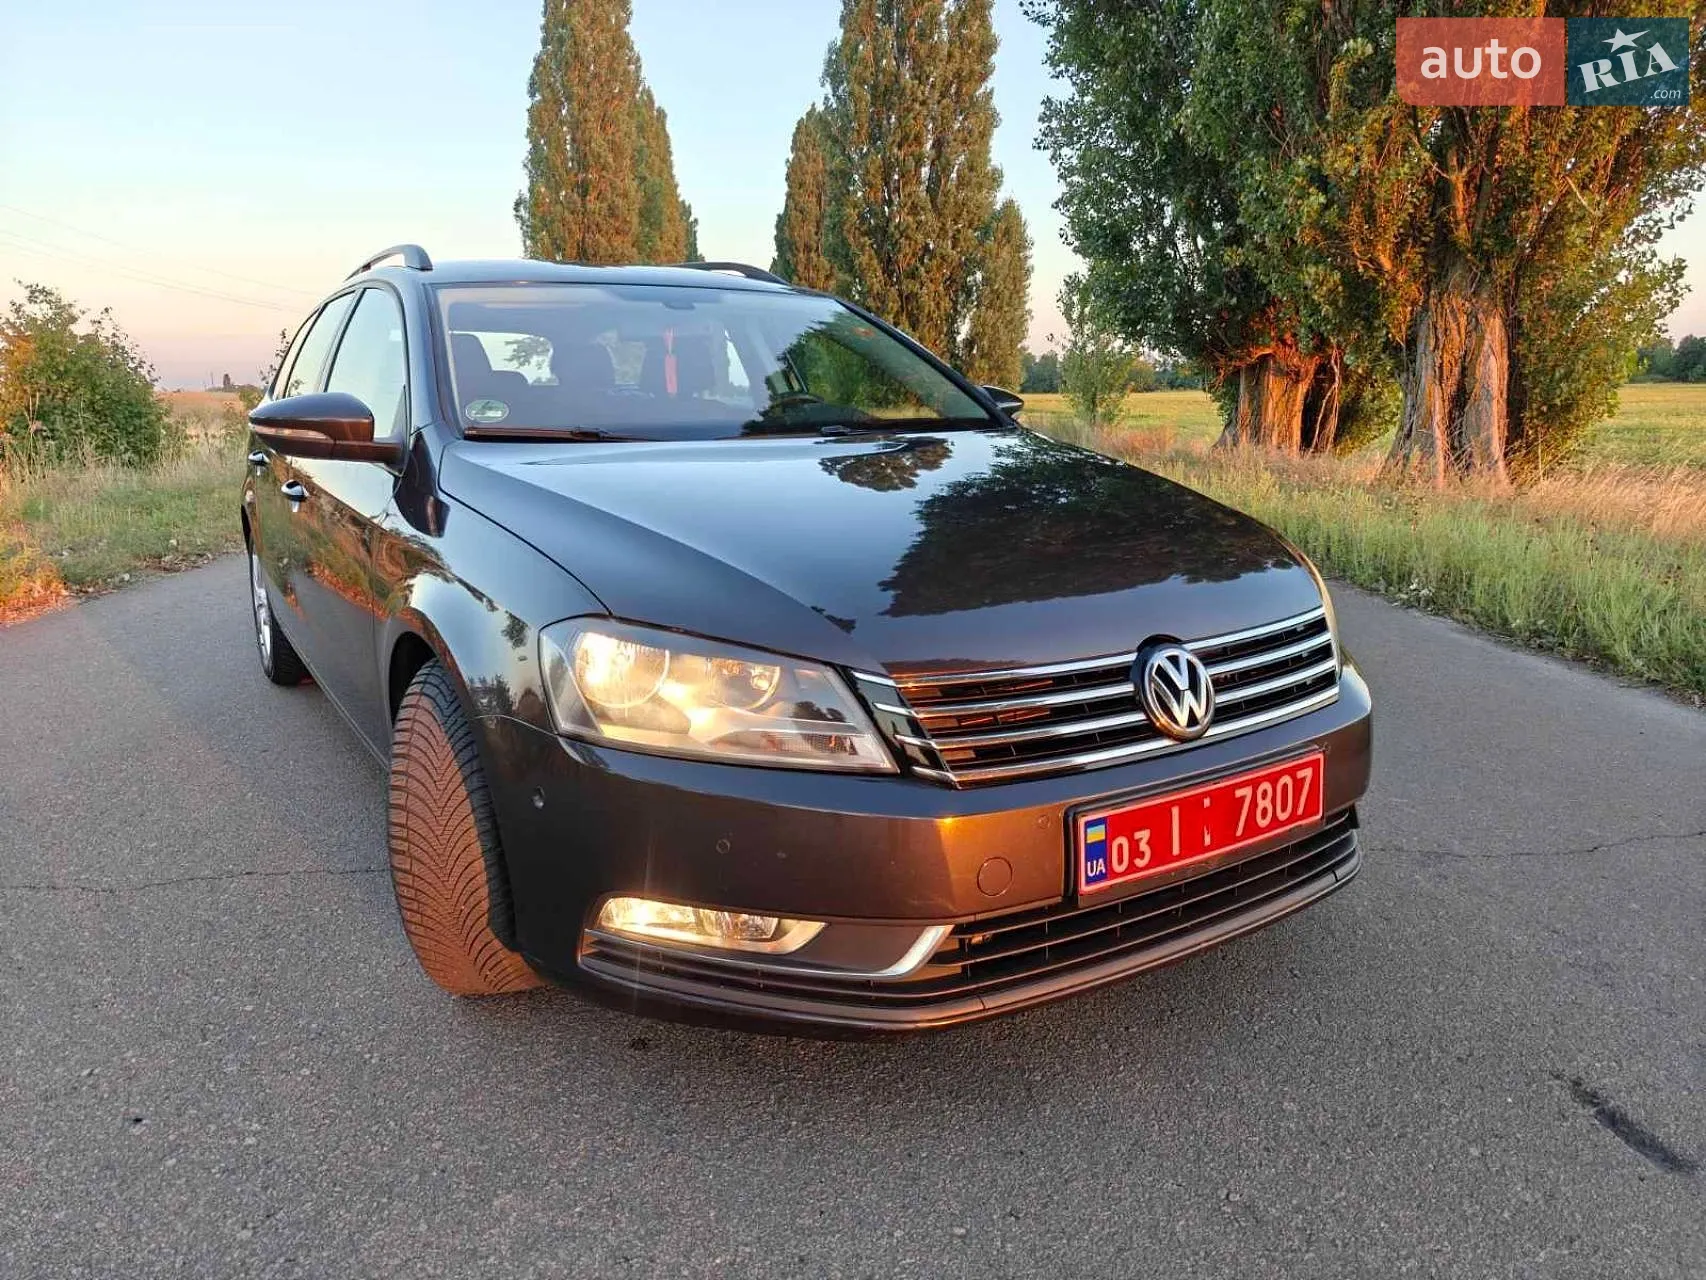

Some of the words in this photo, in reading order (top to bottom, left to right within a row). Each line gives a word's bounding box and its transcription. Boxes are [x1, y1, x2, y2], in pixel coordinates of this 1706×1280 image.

[1111, 828, 1152, 874] 03
[1235, 767, 1314, 837] 7807
[1086, 857, 1106, 876] UA
